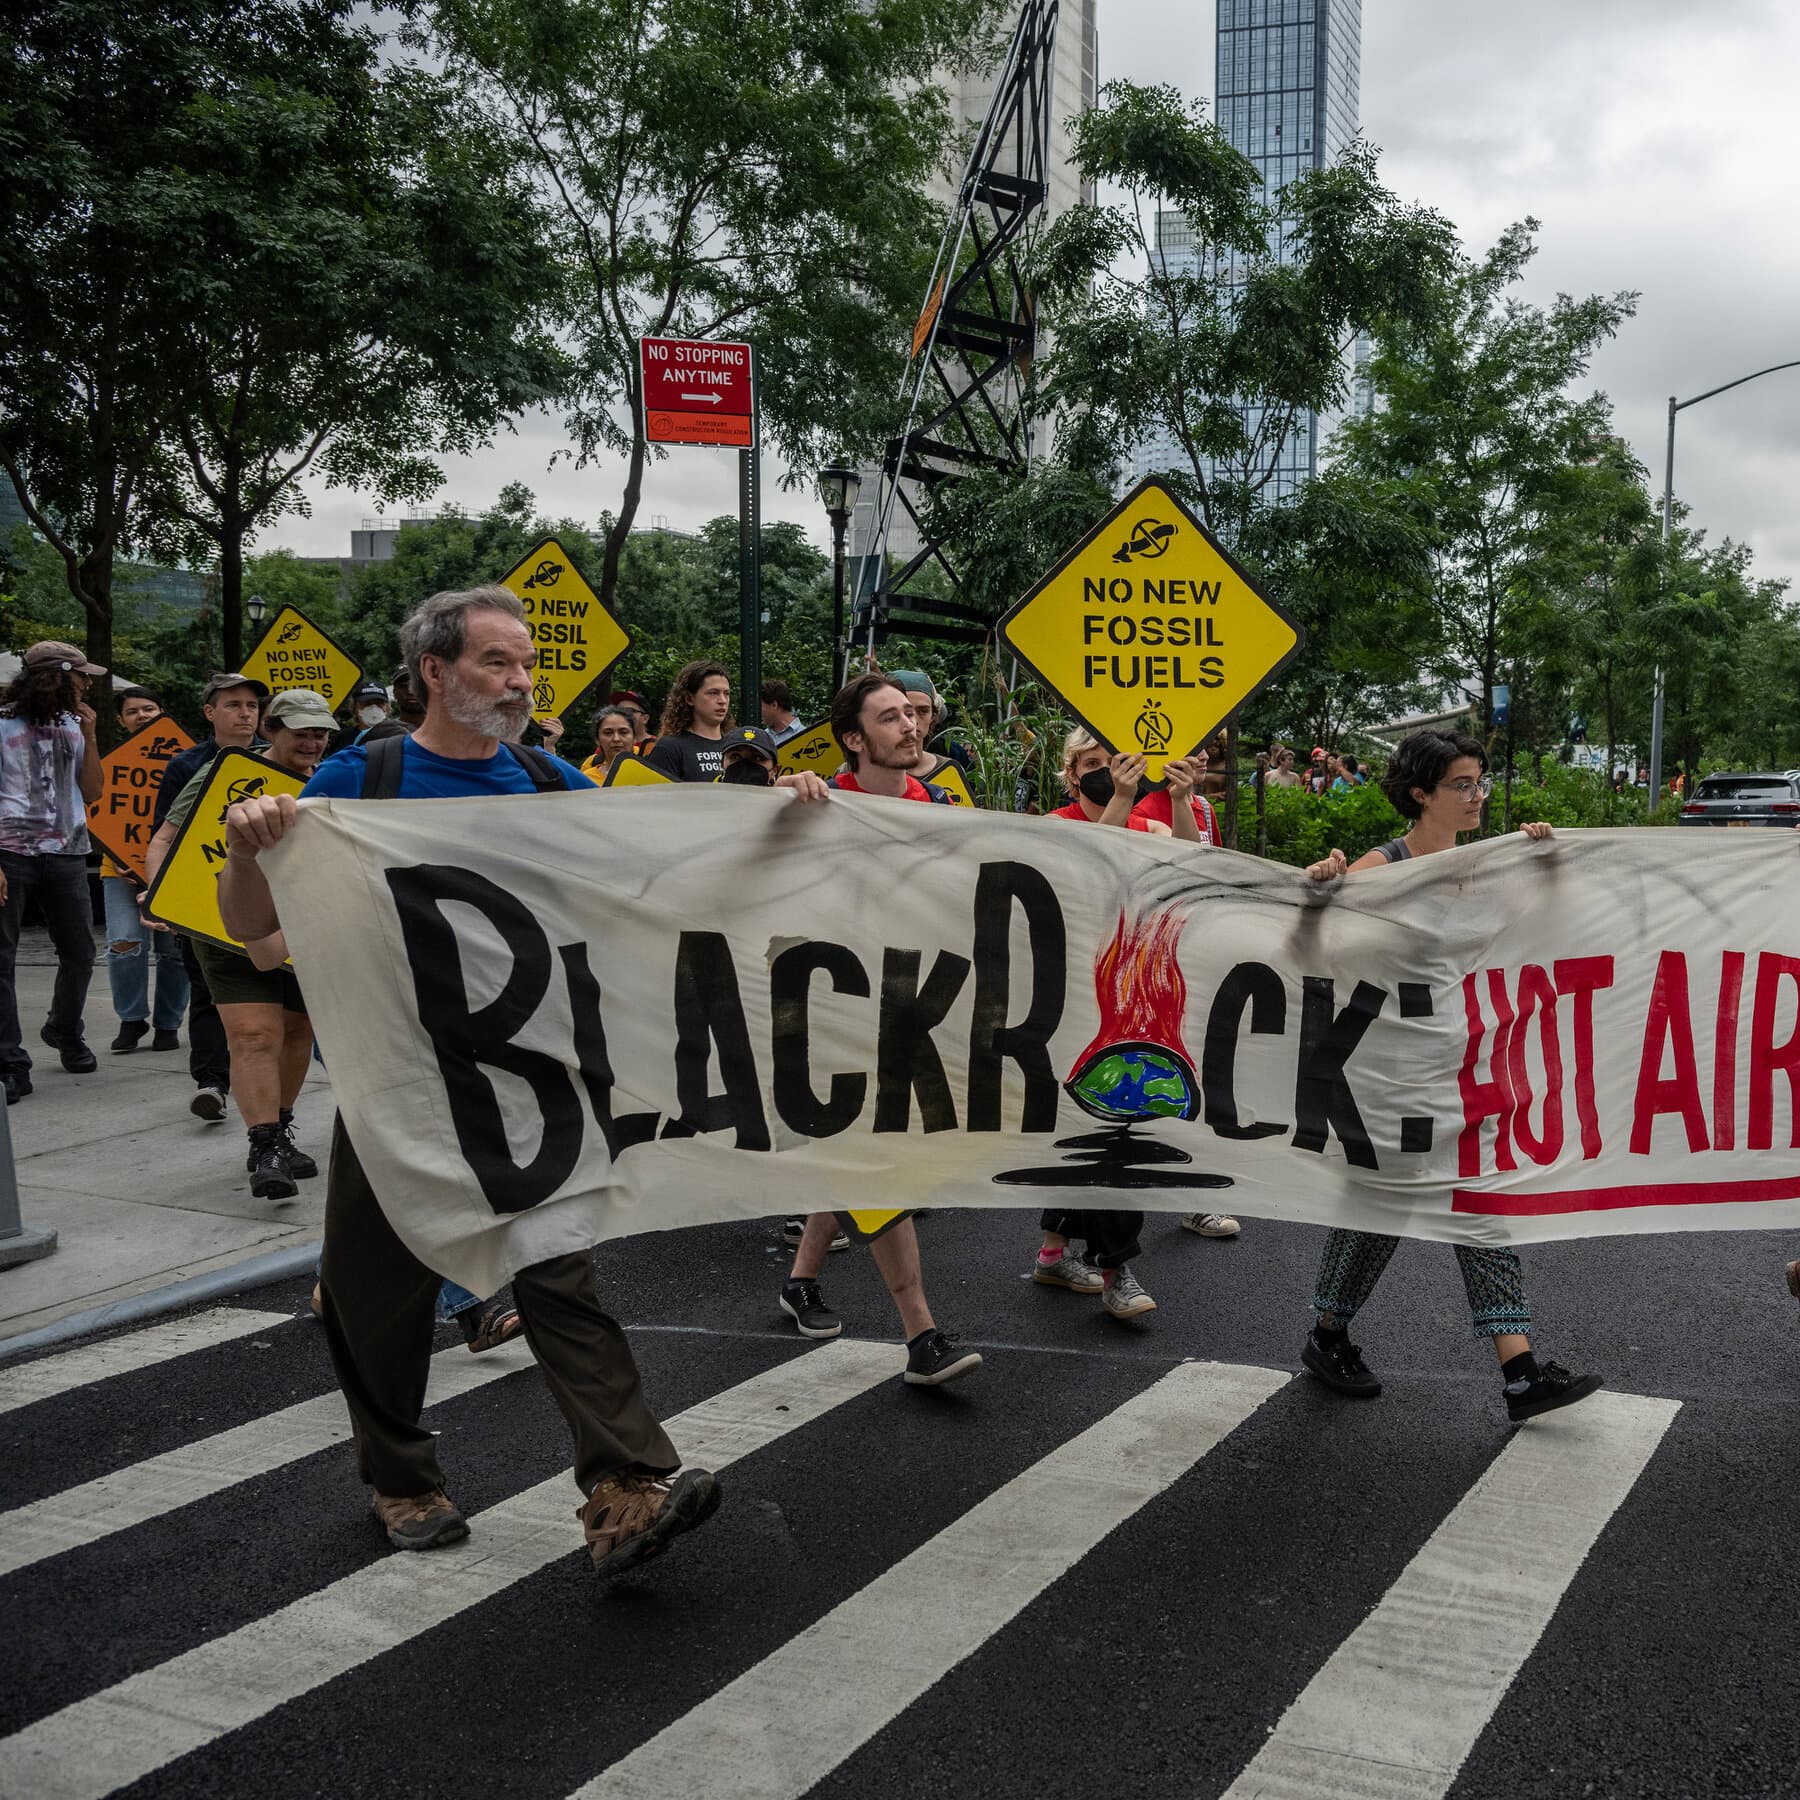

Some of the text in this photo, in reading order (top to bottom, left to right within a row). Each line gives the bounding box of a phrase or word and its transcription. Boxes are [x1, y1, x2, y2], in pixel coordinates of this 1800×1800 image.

[648, 345, 743, 365] NO STOPPING
[662, 368, 733, 386] ANYTIME
[1083, 577, 1222, 605] NO NEW
[522, 597, 589, 618] O NEW
[1083, 615, 1224, 647] FOSSIL
[266, 648, 327, 664] NO NEW
[534, 647, 586, 671] ELS
[269, 665, 331, 682] FOSSIL
[1084, 656, 1225, 689] FUELS
[112, 765, 165, 789] FOS
[110, 793, 151, 817] FU
[1457, 954, 1615, 1178] HOT
[1629, 949, 1800, 1156] AIR
